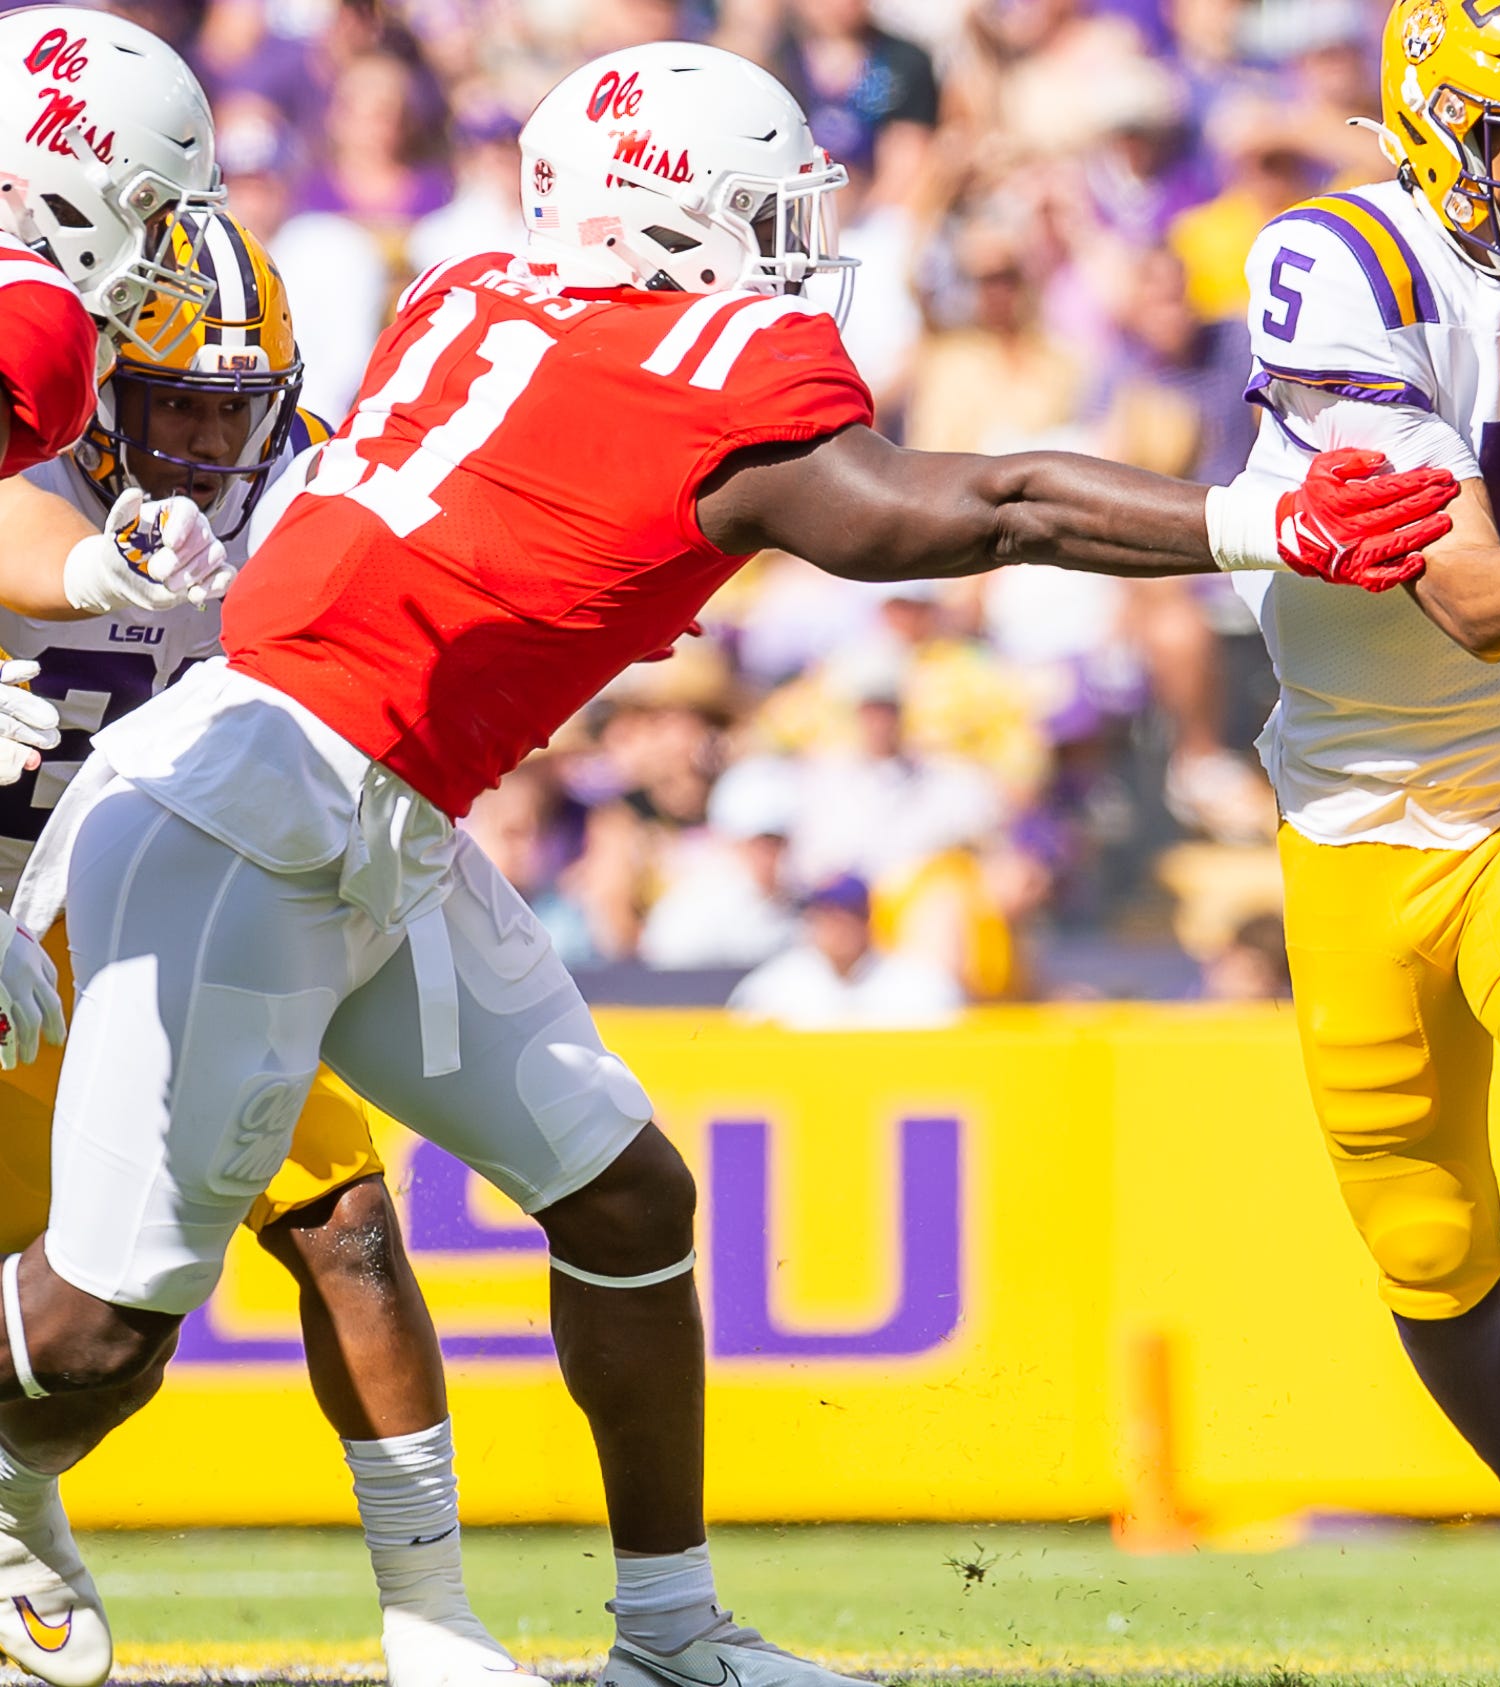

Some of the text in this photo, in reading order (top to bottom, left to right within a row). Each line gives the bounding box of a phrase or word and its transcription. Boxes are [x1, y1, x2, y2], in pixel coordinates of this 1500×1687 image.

[23, 28, 88, 82] Ole
[586, 70, 643, 123] Ole
[25, 87, 115, 165] Miss
[606, 130, 694, 188] Miss
[1263, 246, 1316, 343] 5
[218, 354, 258, 371] LSU
[305, 286, 558, 538] 11
[108, 623, 165, 645] LSU
